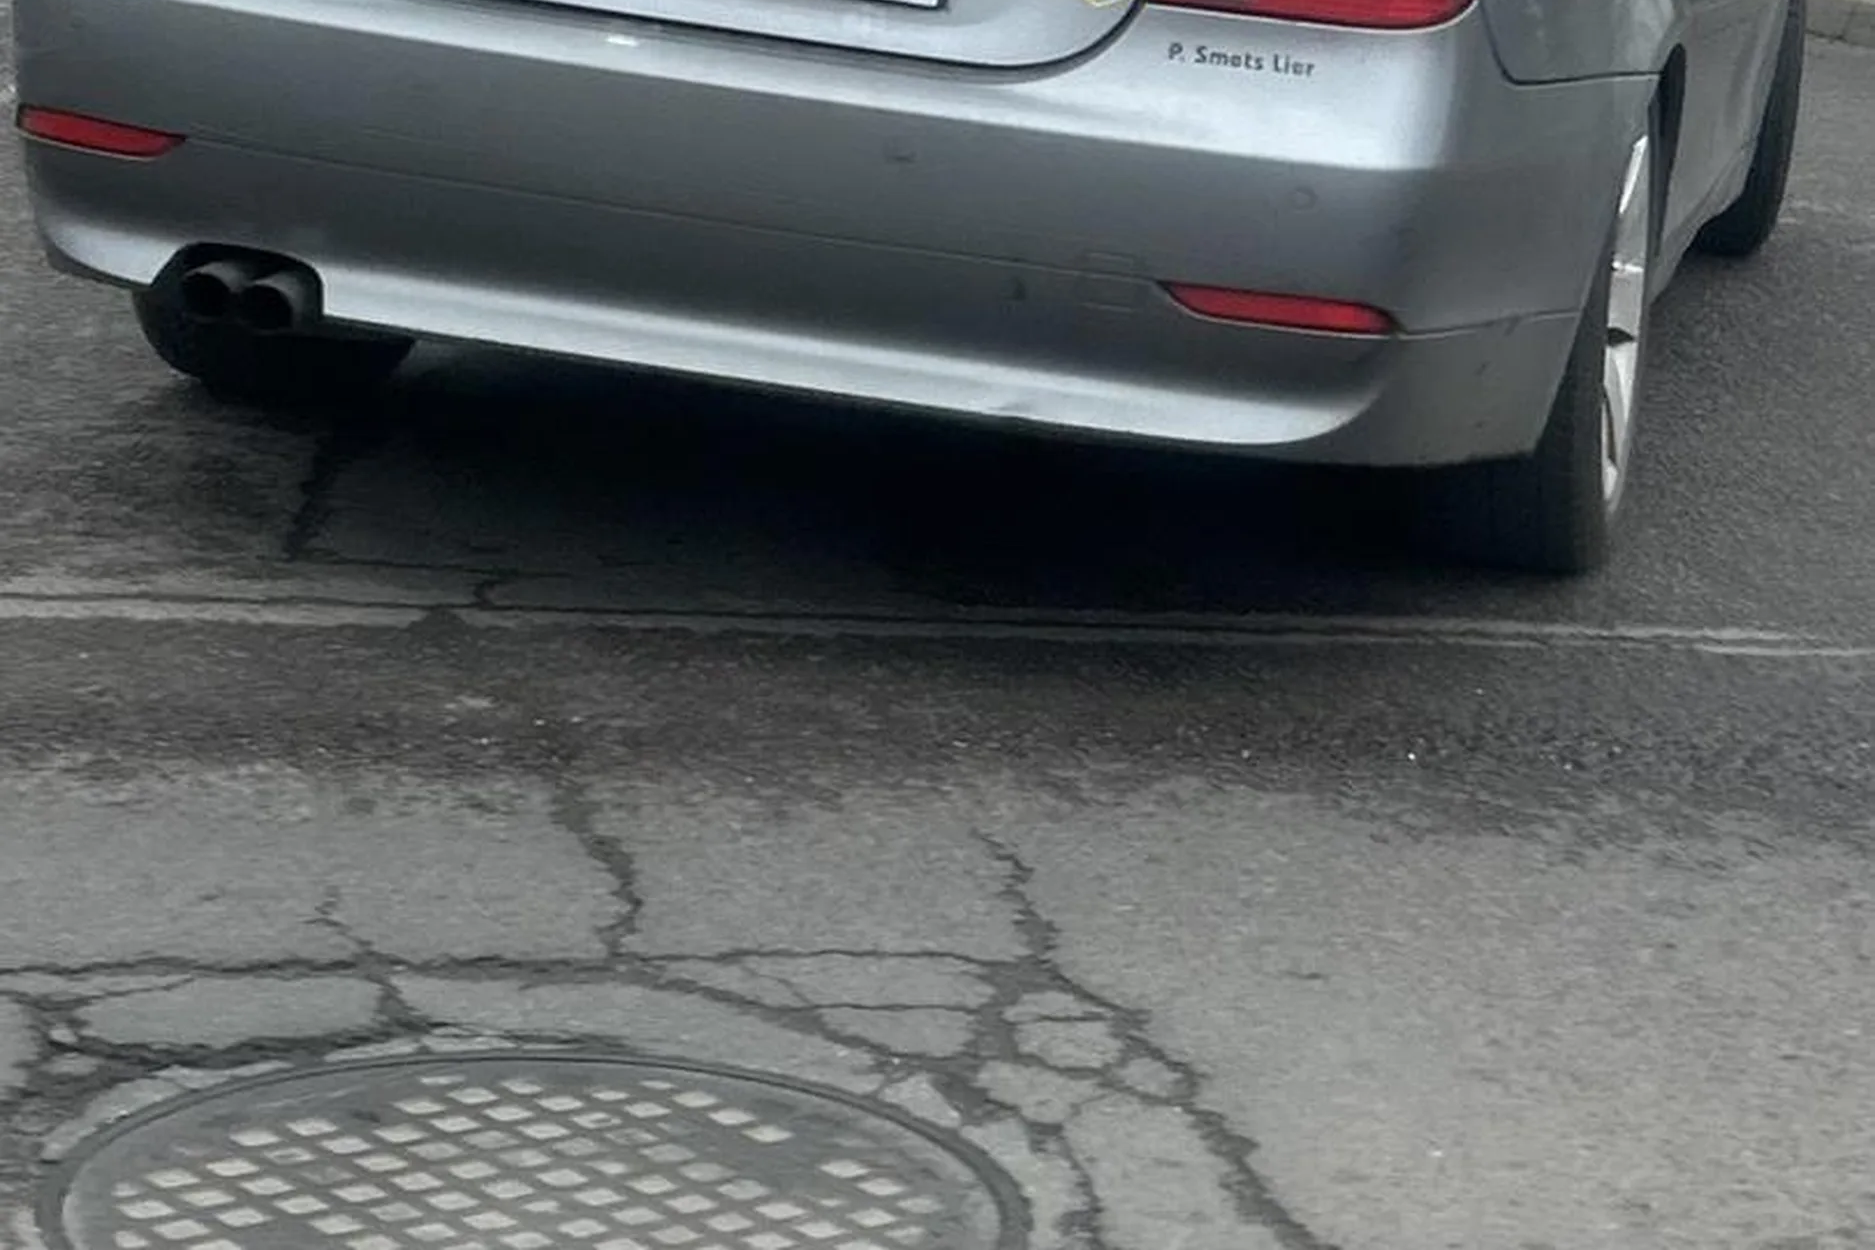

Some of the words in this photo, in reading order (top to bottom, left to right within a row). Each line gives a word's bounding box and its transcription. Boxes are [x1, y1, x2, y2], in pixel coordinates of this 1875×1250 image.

[1167, 41, 1186, 63] P.
[1194, 45, 1265, 71] Smets
[1272, 52, 1315, 77] Lier
